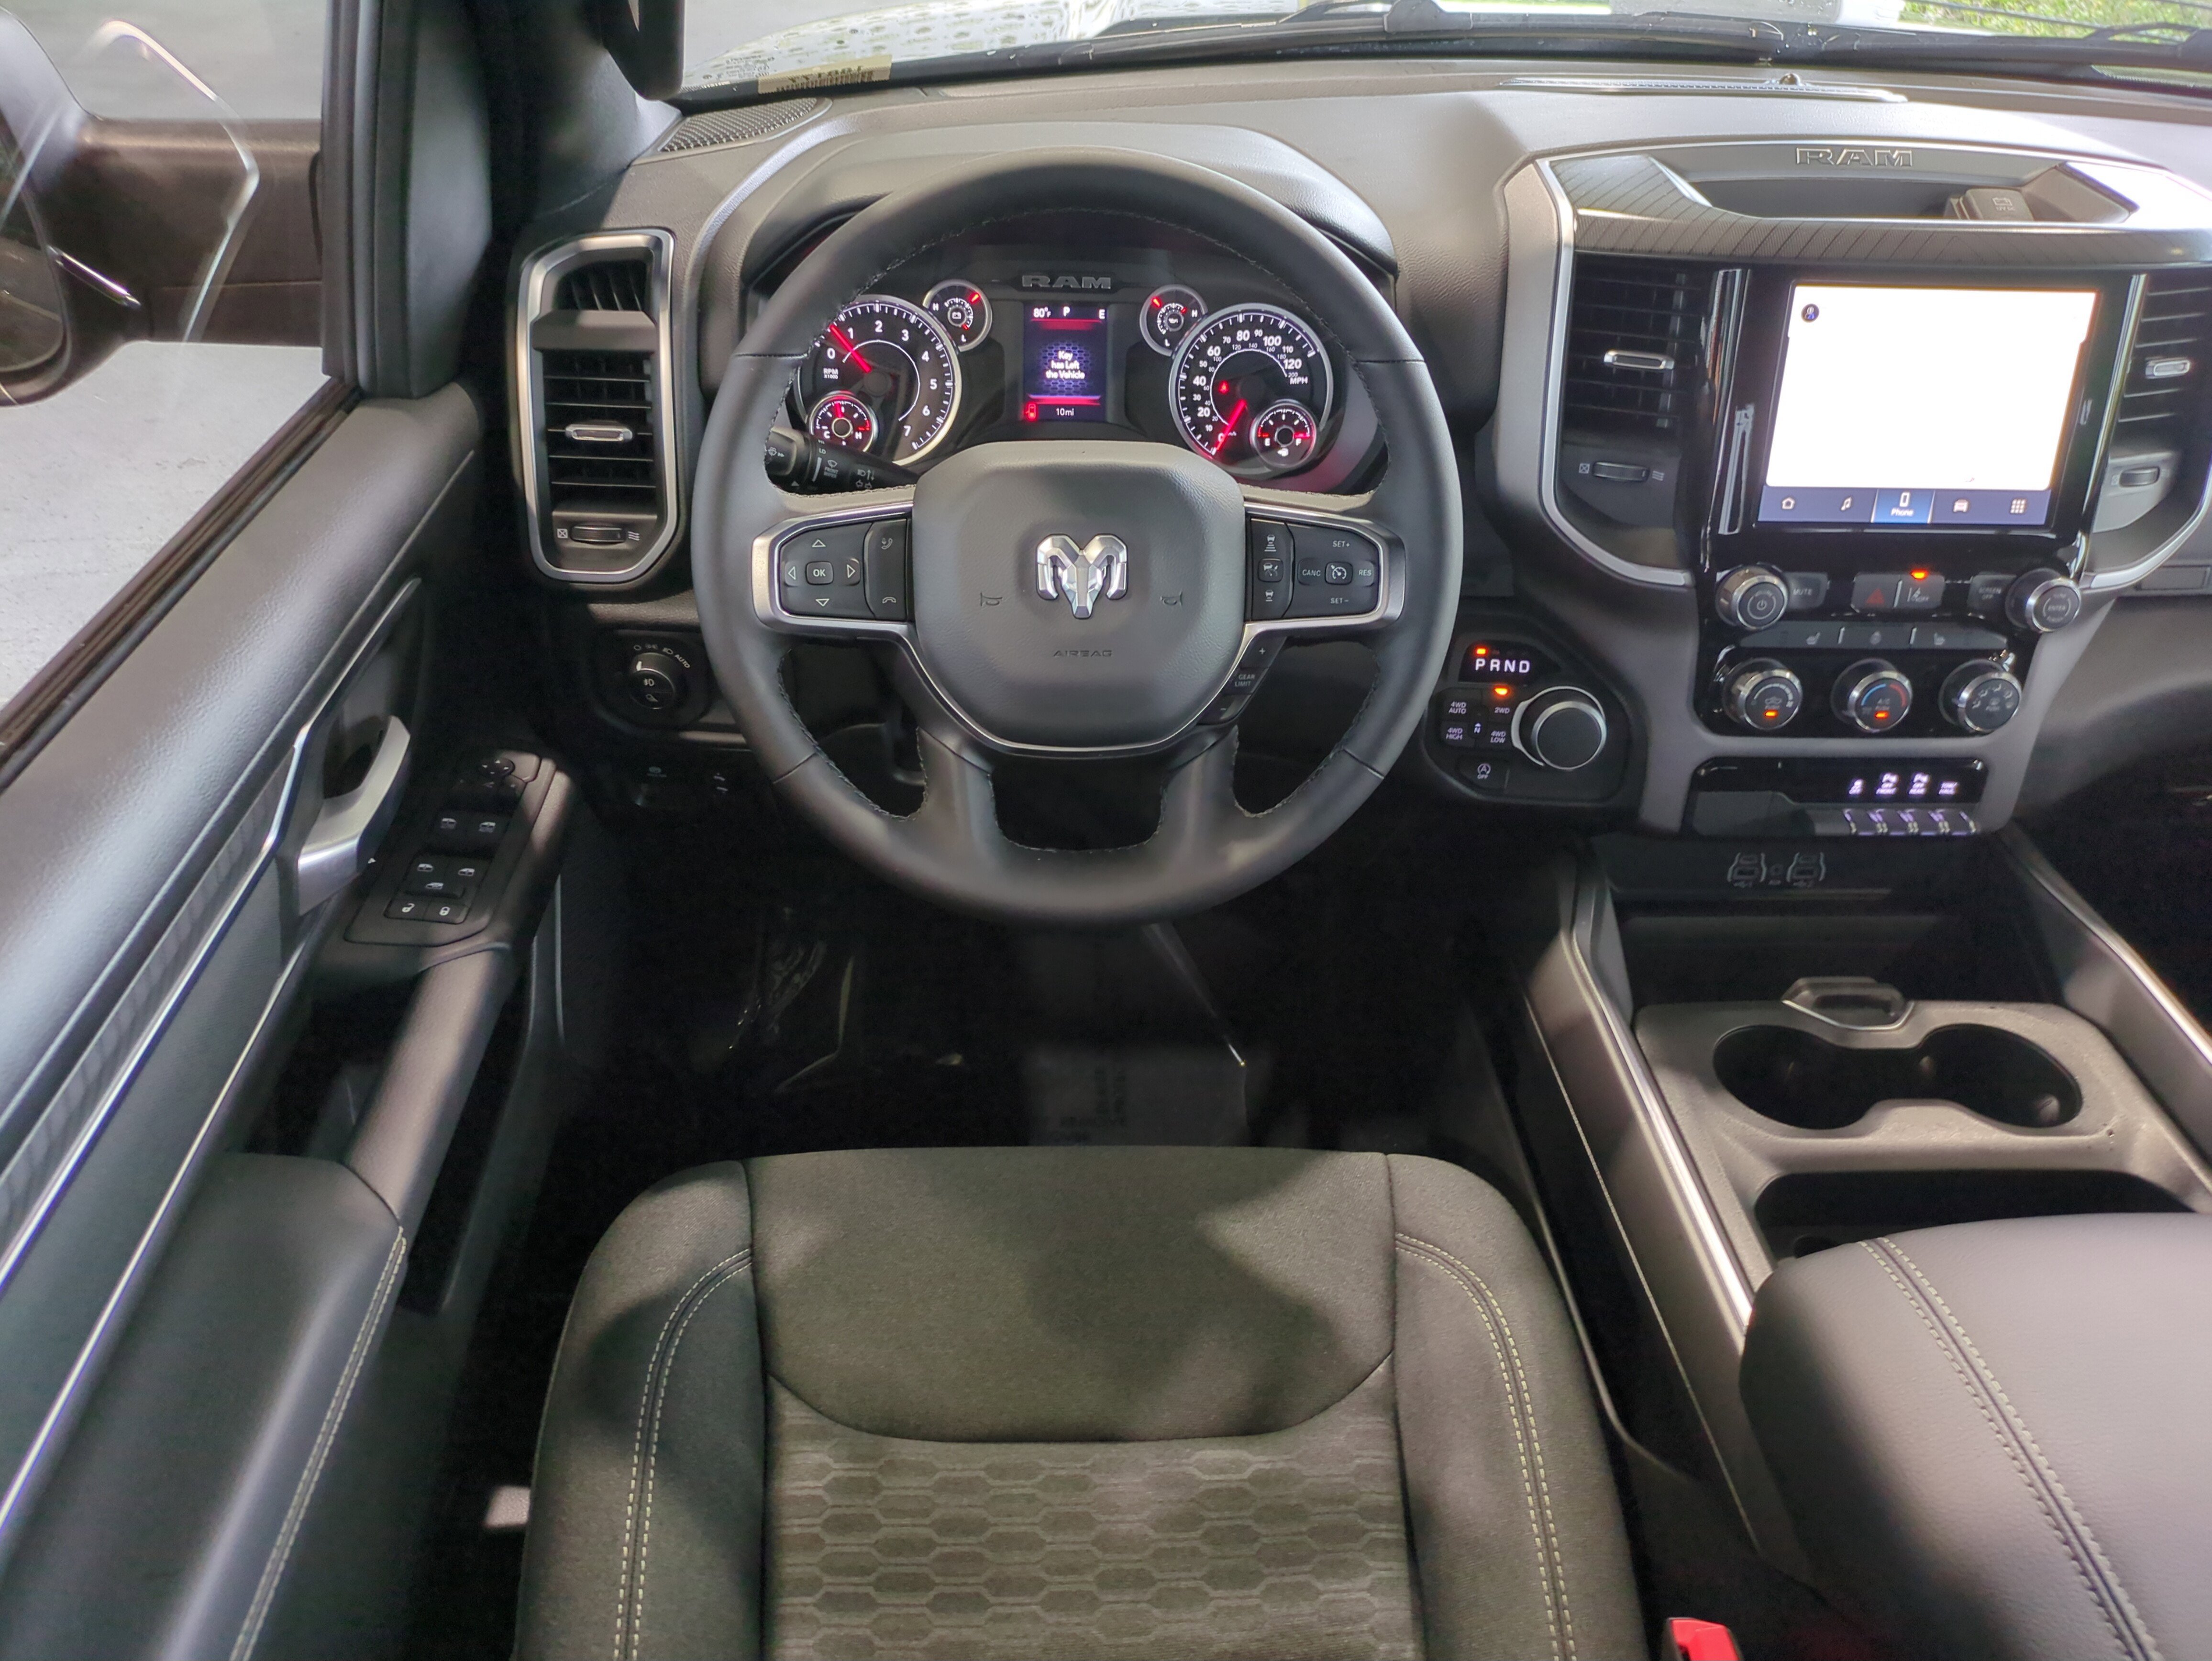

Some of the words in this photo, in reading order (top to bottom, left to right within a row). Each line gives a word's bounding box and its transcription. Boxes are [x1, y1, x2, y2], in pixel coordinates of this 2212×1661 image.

[1796, 148, 1913, 167] RAM
[1022, 276, 1111, 289] RAM
[1063, 307, 1070, 317] P
[1099, 310, 1105, 319] E
[875, 321, 883, 332] 2
[848, 328, 853, 338] 1
[902, 330, 909, 341] 3
[1237, 331, 1250, 342] 80
[1263, 335, 1282, 347] 100
[828, 348, 835, 359] 0
[921, 351, 929, 362] 4
[1058, 351, 1073, 360] Key
[1207, 346, 1221, 357] 60
[1051, 361, 1063, 369] has
[1066, 361, 1080, 369] Left
[1284, 359, 1302, 370] 120
[1059, 371, 1085, 379] Vehicle
[930, 379, 937, 389] 5
[1193, 376, 1206, 386] 40
[922, 405, 930, 415] 6
[1197, 407, 1210, 417] 20
[904, 426, 911, 436] 7
[1891, 508, 1913, 516] Phone
[675, 654, 690, 668] AUTO
